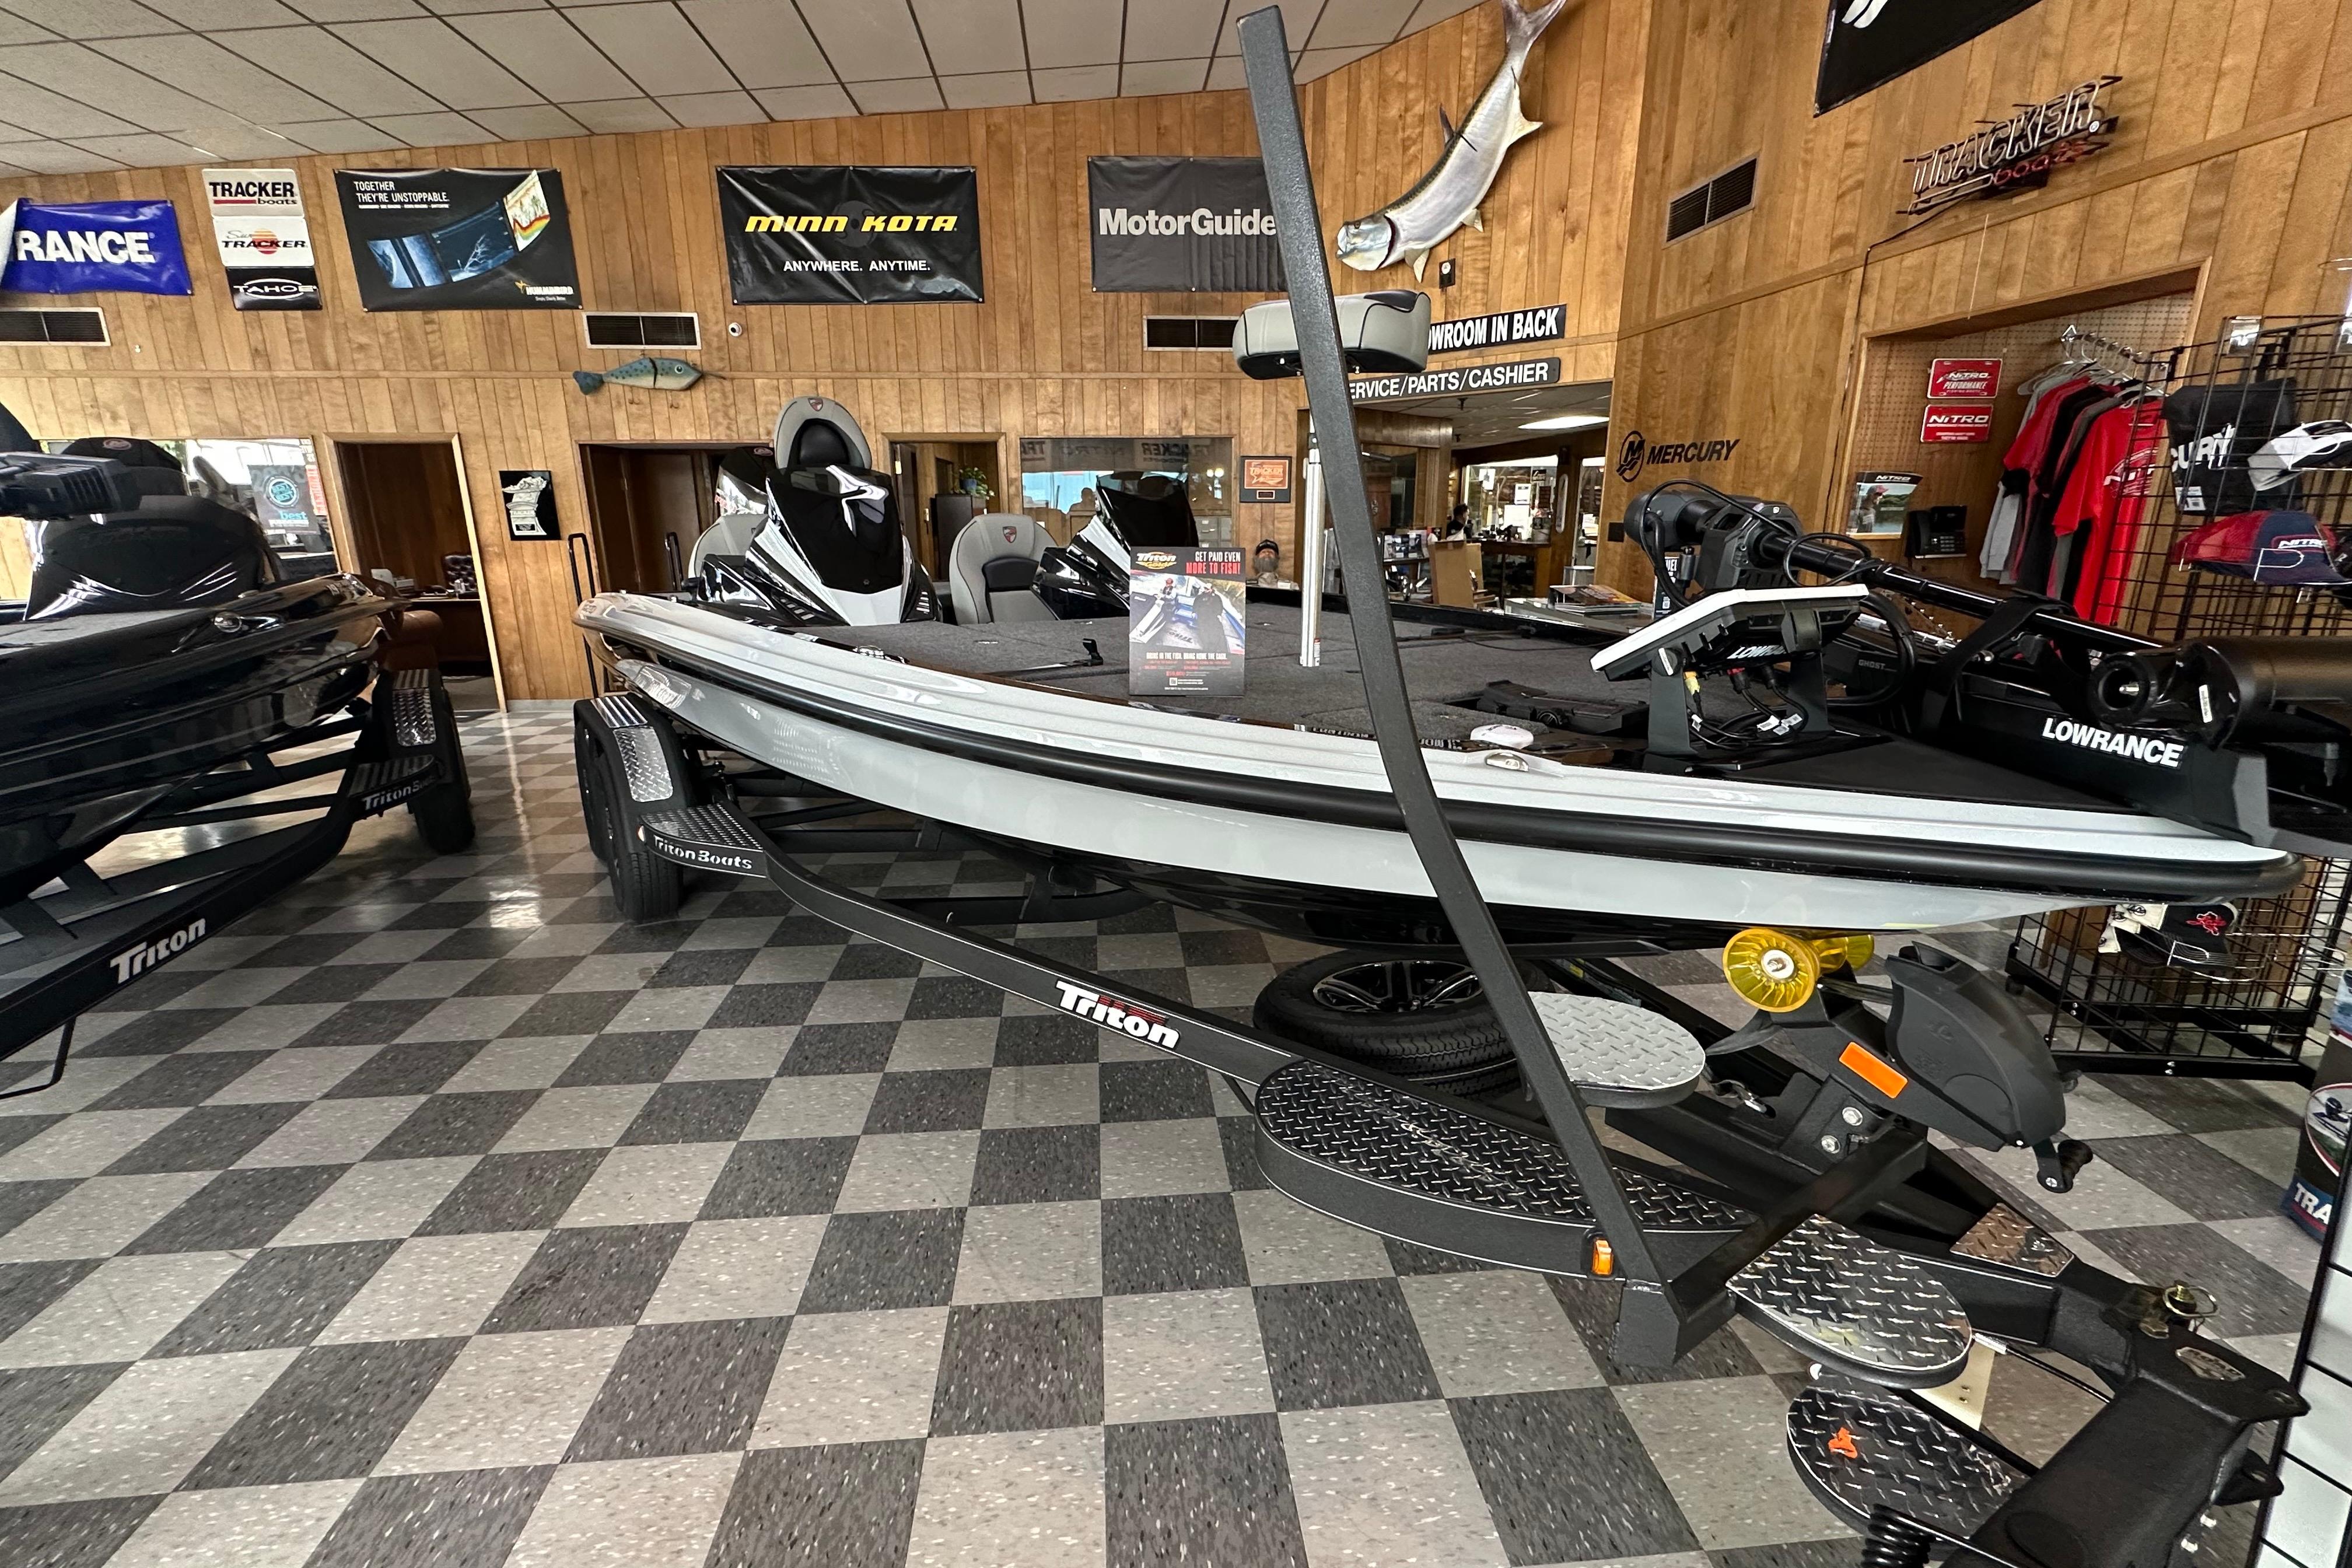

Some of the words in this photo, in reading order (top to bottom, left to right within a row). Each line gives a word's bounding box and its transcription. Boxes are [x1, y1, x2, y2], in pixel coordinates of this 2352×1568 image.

[1912, 79, 2100, 193] TRACKER
[209, 181, 295, 198] TRACKER
[354, 181, 396, 191] TOGETHER
[356, 192, 390, 202] THEY'RE
[744, 215, 849, 232] MINN
[860, 215, 958, 232] KOTA
[1099, 208, 1277, 236] MotorGuide
[16, 230, 156, 264] RANCE
[222, 240, 307, 249] TRACKER
[783, 260, 863, 272] ANYWHERE.
[869, 260, 931, 271] ANYTIME.
[233, 285, 314, 293] TAHOE
[1428, 317, 1488, 351] WROOM
[1490, 314, 1509, 343] IN
[1511, 307, 1560, 340] BACK
[1943, 381, 1989, 390] PERFORMANCE
[1929, 415, 1990, 424] NITRO
[1646, 439, 1741, 465] MERCURY
[1137, 553, 1177, 562] Triton
[1195, 551, 1207, 562] GET
[1208, 551, 1223, 562] PAID
[1224, 552, 1241, 562] EVEN
[1186, 562, 1206, 574] MORE
[1209, 562, 1218, 574] TO
[1220, 562, 1241, 574] FISH!
[1859, 659, 1885, 670] GHOST
[2042, 718, 2185, 768] LOWRANCE
[110, 918, 206, 984] Triton
[1056, 980, 1181, 1049] Triton
[2294, 1182, 2332, 1225] TRA
